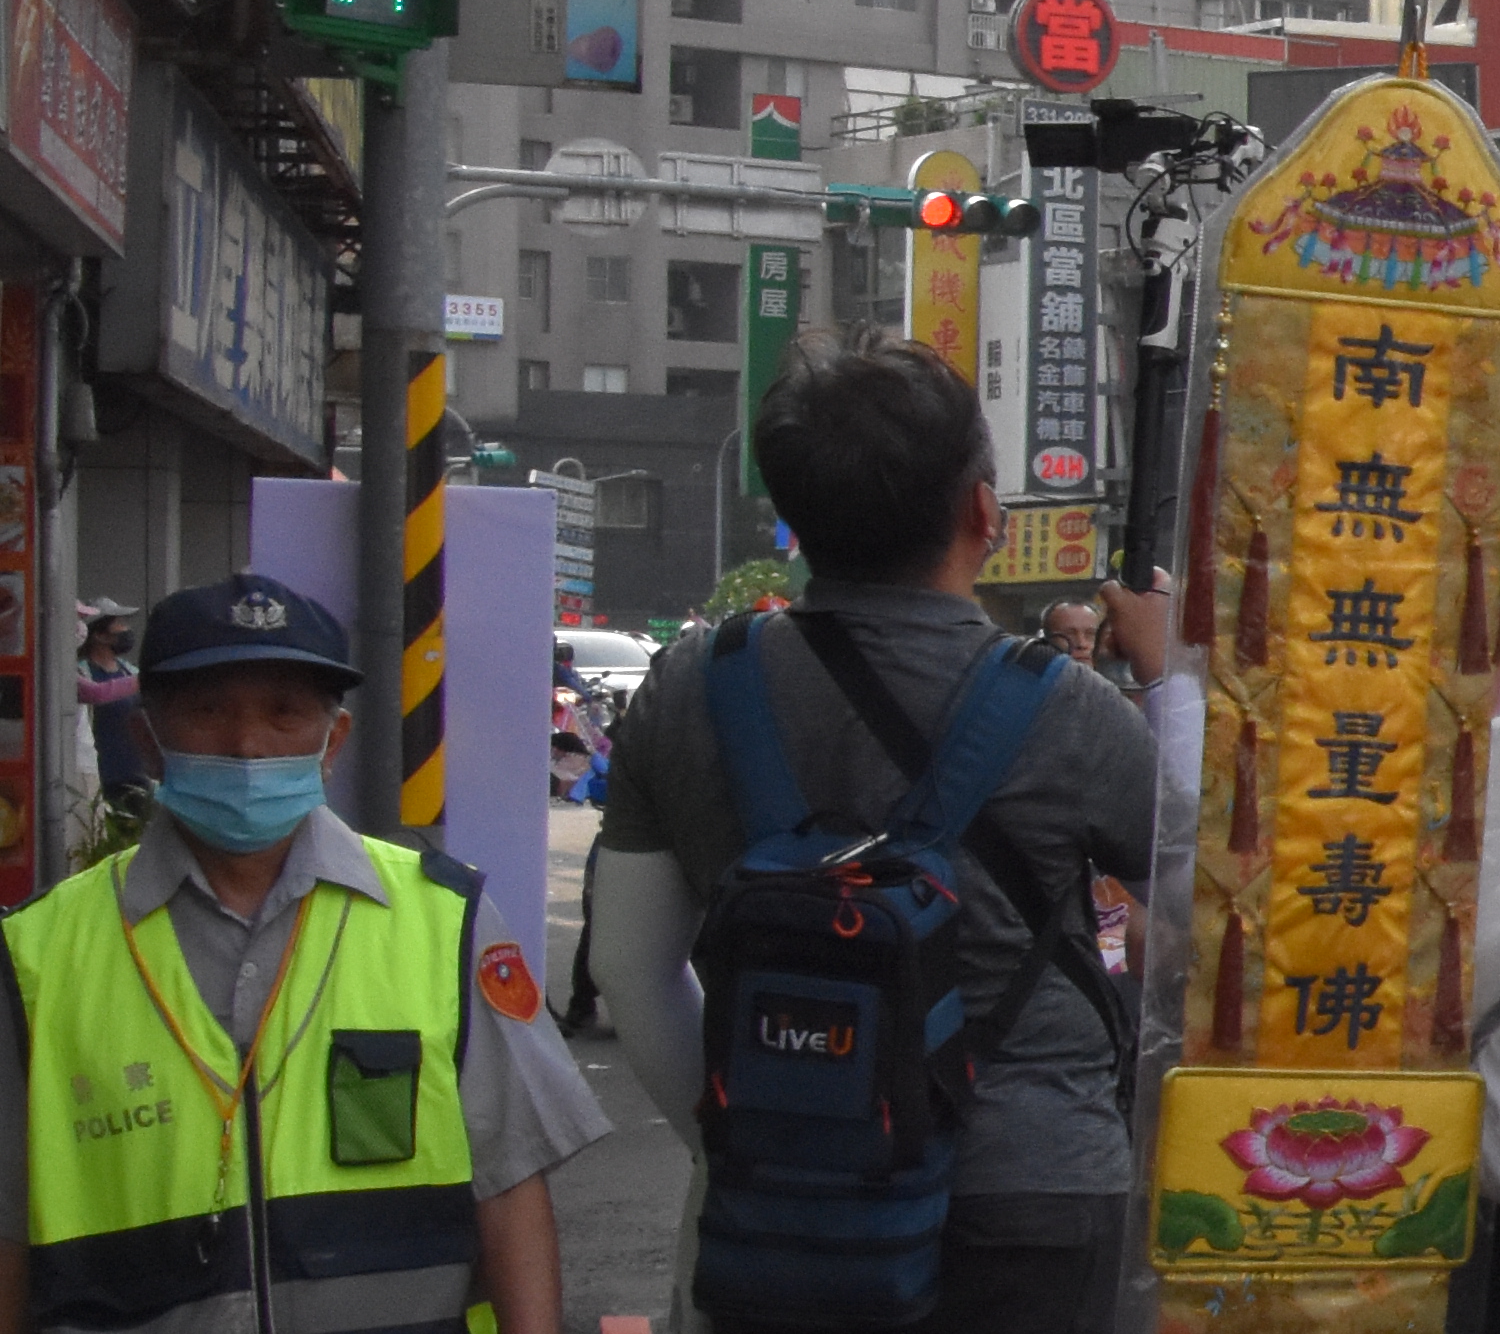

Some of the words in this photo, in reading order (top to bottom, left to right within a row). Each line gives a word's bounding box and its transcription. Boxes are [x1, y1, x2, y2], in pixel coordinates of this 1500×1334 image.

[1039, 166, 1086, 334] 北區當舖
[757, 250, 789, 320] 房屋
[448, 302, 499, 318] 3355
[1039, 454, 1085, 480] 24H
[1288, 324, 1436, 1051] 南無無量壽佛
[758, 1011, 855, 1058] LiveU
[72, 1099, 174, 1144] POLICE
